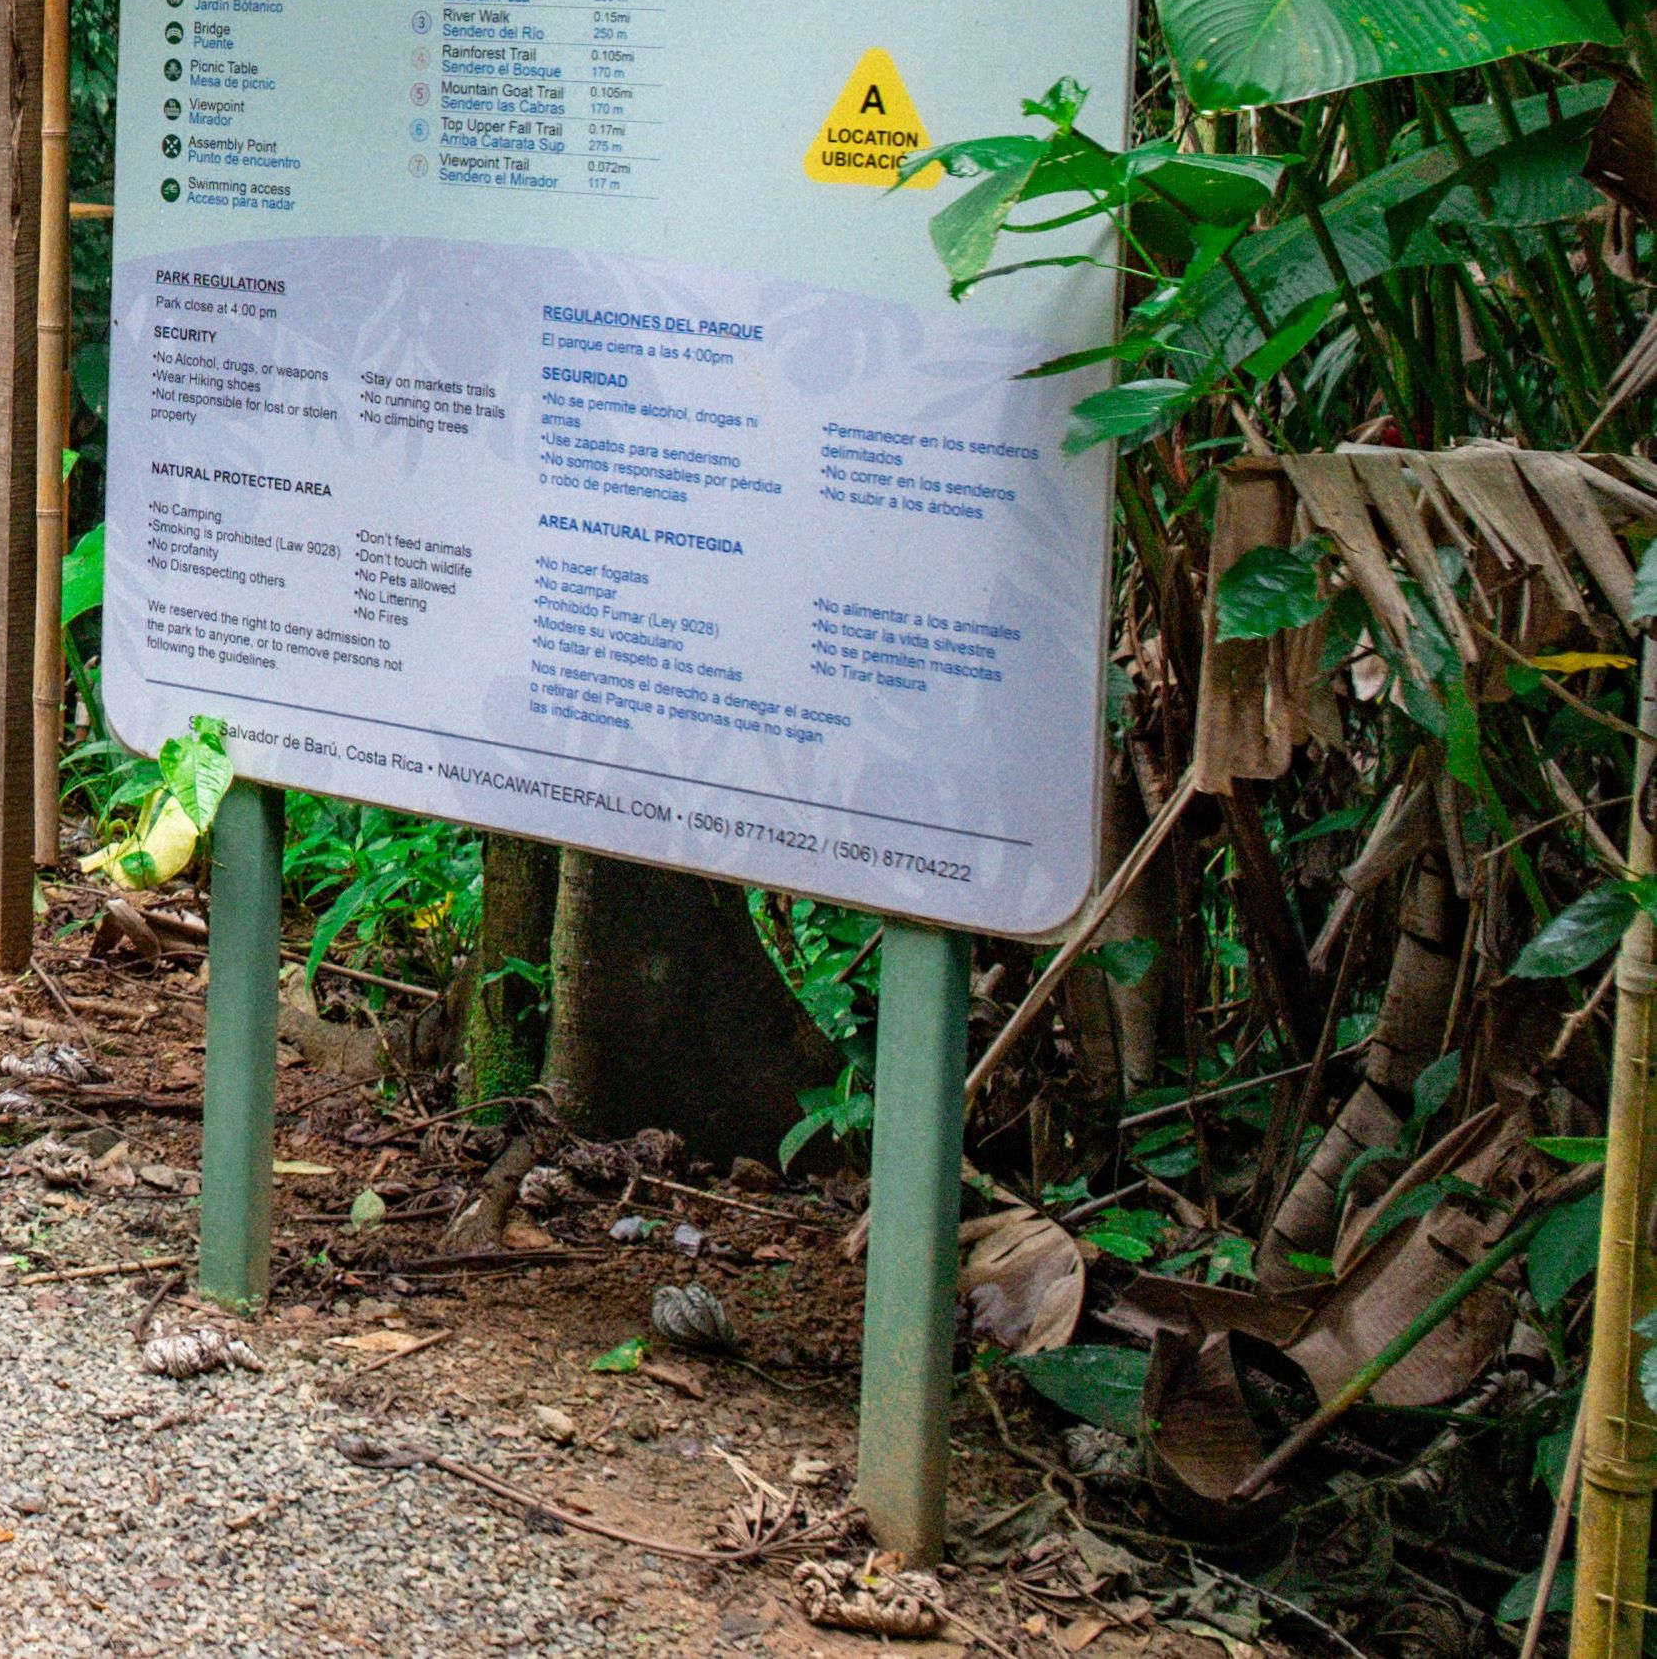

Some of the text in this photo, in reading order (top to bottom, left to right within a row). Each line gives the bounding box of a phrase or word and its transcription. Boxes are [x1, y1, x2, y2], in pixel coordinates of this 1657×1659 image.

[444, 9, 509, 23] River Walk
[195, 22, 230, 35] Bridge
[194, 36, 233, 49] Puente
[443, 45, 536, 61] Rainforest Trail
[191, 60, 258, 75] Picnic Table
[190, 75, 275, 92] Mesa de picnic
[441, 81, 564, 99] Mountain Goat Trail
[189, 99, 244, 113] Viewpoint
[860, 85, 885, 115] A
[189, 113, 232, 126] Mirador
[441, 117, 562, 136] Top Upper Fall Trail
[189, 137, 277, 153] Assembly Point
[828, 128, 918, 148] LOCATION
[189, 151, 301, 169] Punto de encuentro
[440, 154, 529, 171] Viewpoint Trail
[822, 150, 908, 170] UBICACI
[189, 177, 291, 196] Swimming access
[188, 192, 295, 210] Acceso para nadar
[156, 270, 285, 293] PARK REGULATIONS
[156, 295, 181, 310] Park
[184, 299, 213, 313] close
[217, 302, 227, 314] at
[259, 308, 277, 319] pm
[544, 306, 763, 340] REGULACIONES DEL PARQUE
[154, 326, 217, 343] SECURITY
[543, 333, 554, 345] El
[558, 336, 603, 352] parque
[607, 339, 643, 355] cierra
[648, 347, 656, 356] a
[660, 345, 678, 359] las
[543, 367, 627, 388] SEGURIDAD
[151, 461, 332, 496] NATURAL PROTECTED AREA
[582, 521, 651, 542] NATURAL
[655, 531, 743, 555] PROTEGIDA
[148, 600, 390, 650] We reserved the right to deny admission to
[146, 636, 194, 657] following
[198, 644, 215, 658] the
[147, 618, 164, 631] the
[167, 623, 192, 639] park
[195, 627, 205, 639] to
[258, 636, 269, 647] or
[272, 638, 282, 650] to
[286, 642, 329, 658] remove
[333, 650, 380, 669] persons
[384, 658, 402, 671] not
[220, 722, 279, 745] Salvador
[282, 734, 300, 749] de
[305, 737, 341, 759] Barú,
[346, 746, 387, 767] Costa
[391, 754, 423, 774] Rica
[438, 763, 671, 823] NAUYACAWATEERFALL.COM
[688, 812, 731, 838] (506)
[735, 822, 818, 852] 87714222
[832, 841, 878, 866] (506)
[882, 851, 972, 882] 87704222
